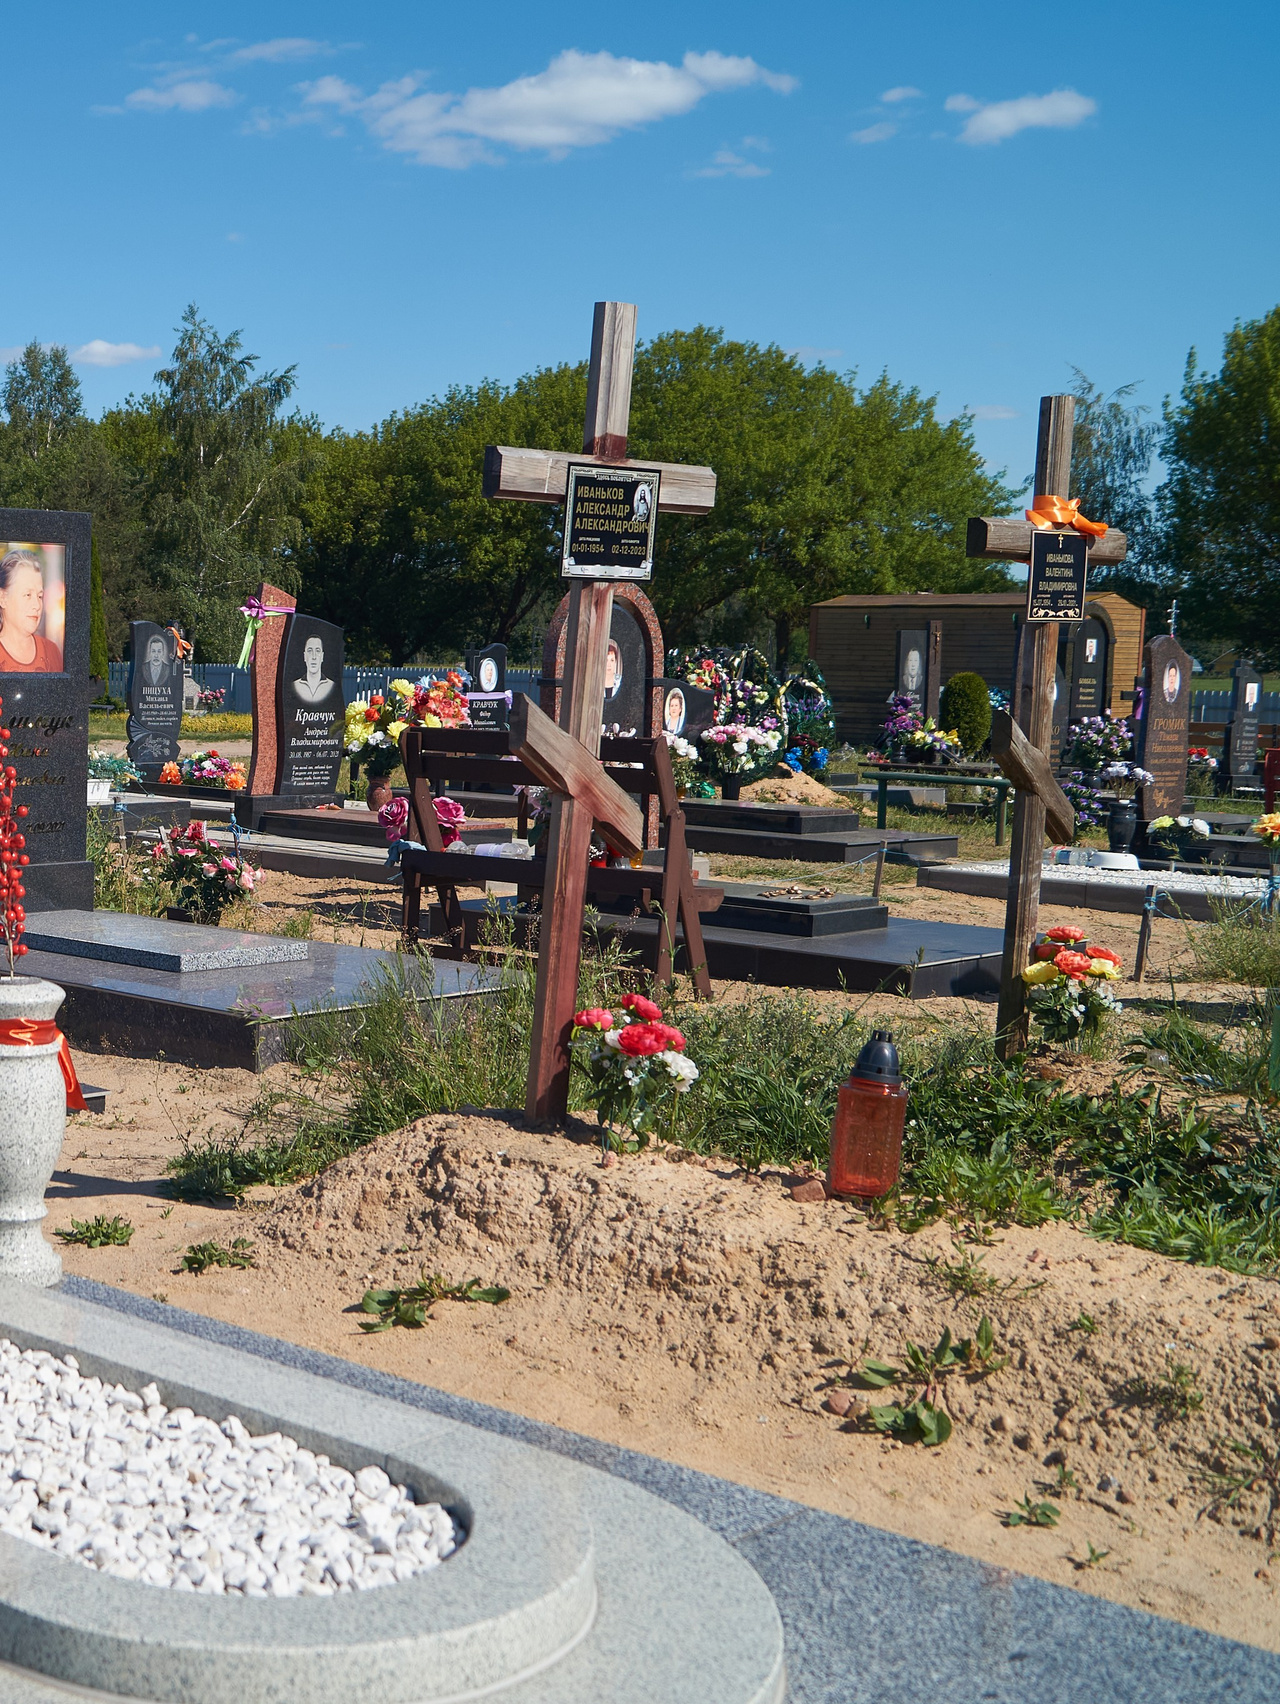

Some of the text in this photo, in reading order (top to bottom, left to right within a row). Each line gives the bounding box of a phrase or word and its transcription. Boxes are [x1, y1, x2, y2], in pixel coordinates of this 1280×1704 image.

[577, 486, 625, 500] ИВАНЬКОВ
[575, 501, 631, 518] АЛЕКСАНДР
[575, 518, 651, 534] АЛЕКСАНДРОВИЧ
[1045, 567, 1074, 578] ВАЛЕНТИНА
[1038, 581, 1078, 593] ВЛАДИМИРОВНА
[472, 701, 499, 709] КРАВЧУК
[295, 708, 336, 725] Кравчук
[1152, 718, 1187, 731] ГРОМИК
[303, 727, 329, 738] Андрей
[290, 737, 339, 748] Владимирович
